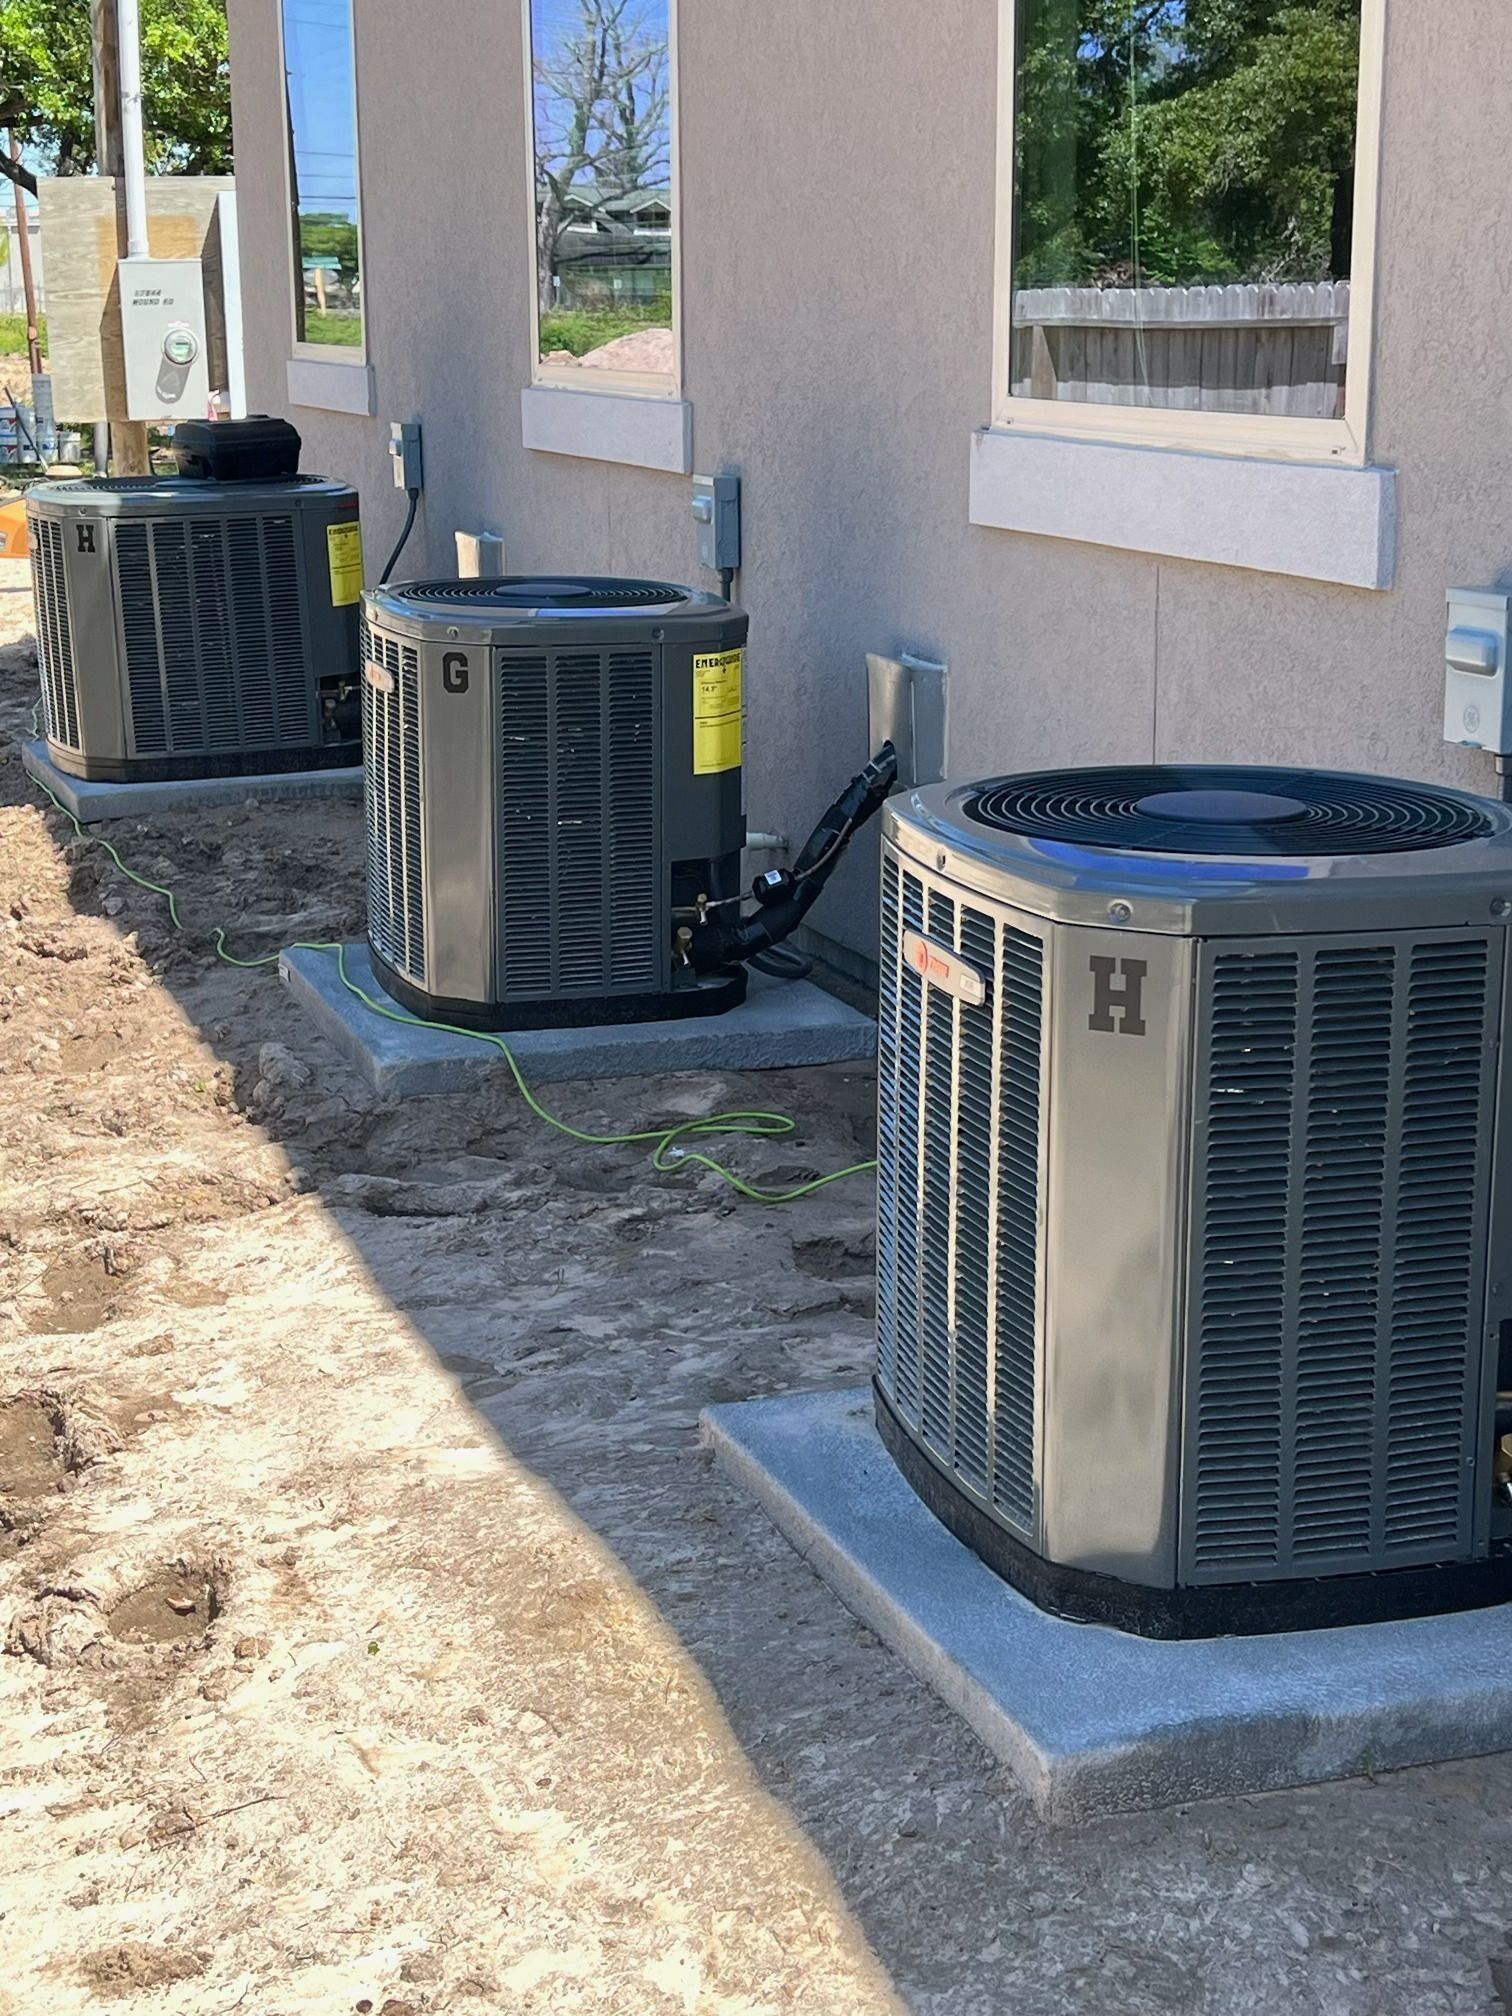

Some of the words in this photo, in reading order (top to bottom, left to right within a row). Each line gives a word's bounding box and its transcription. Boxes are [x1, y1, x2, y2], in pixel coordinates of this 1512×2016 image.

[76, 525, 95, 552] H
[443, 652, 469, 693] G
[1088, 955, 1148, 1036] H
